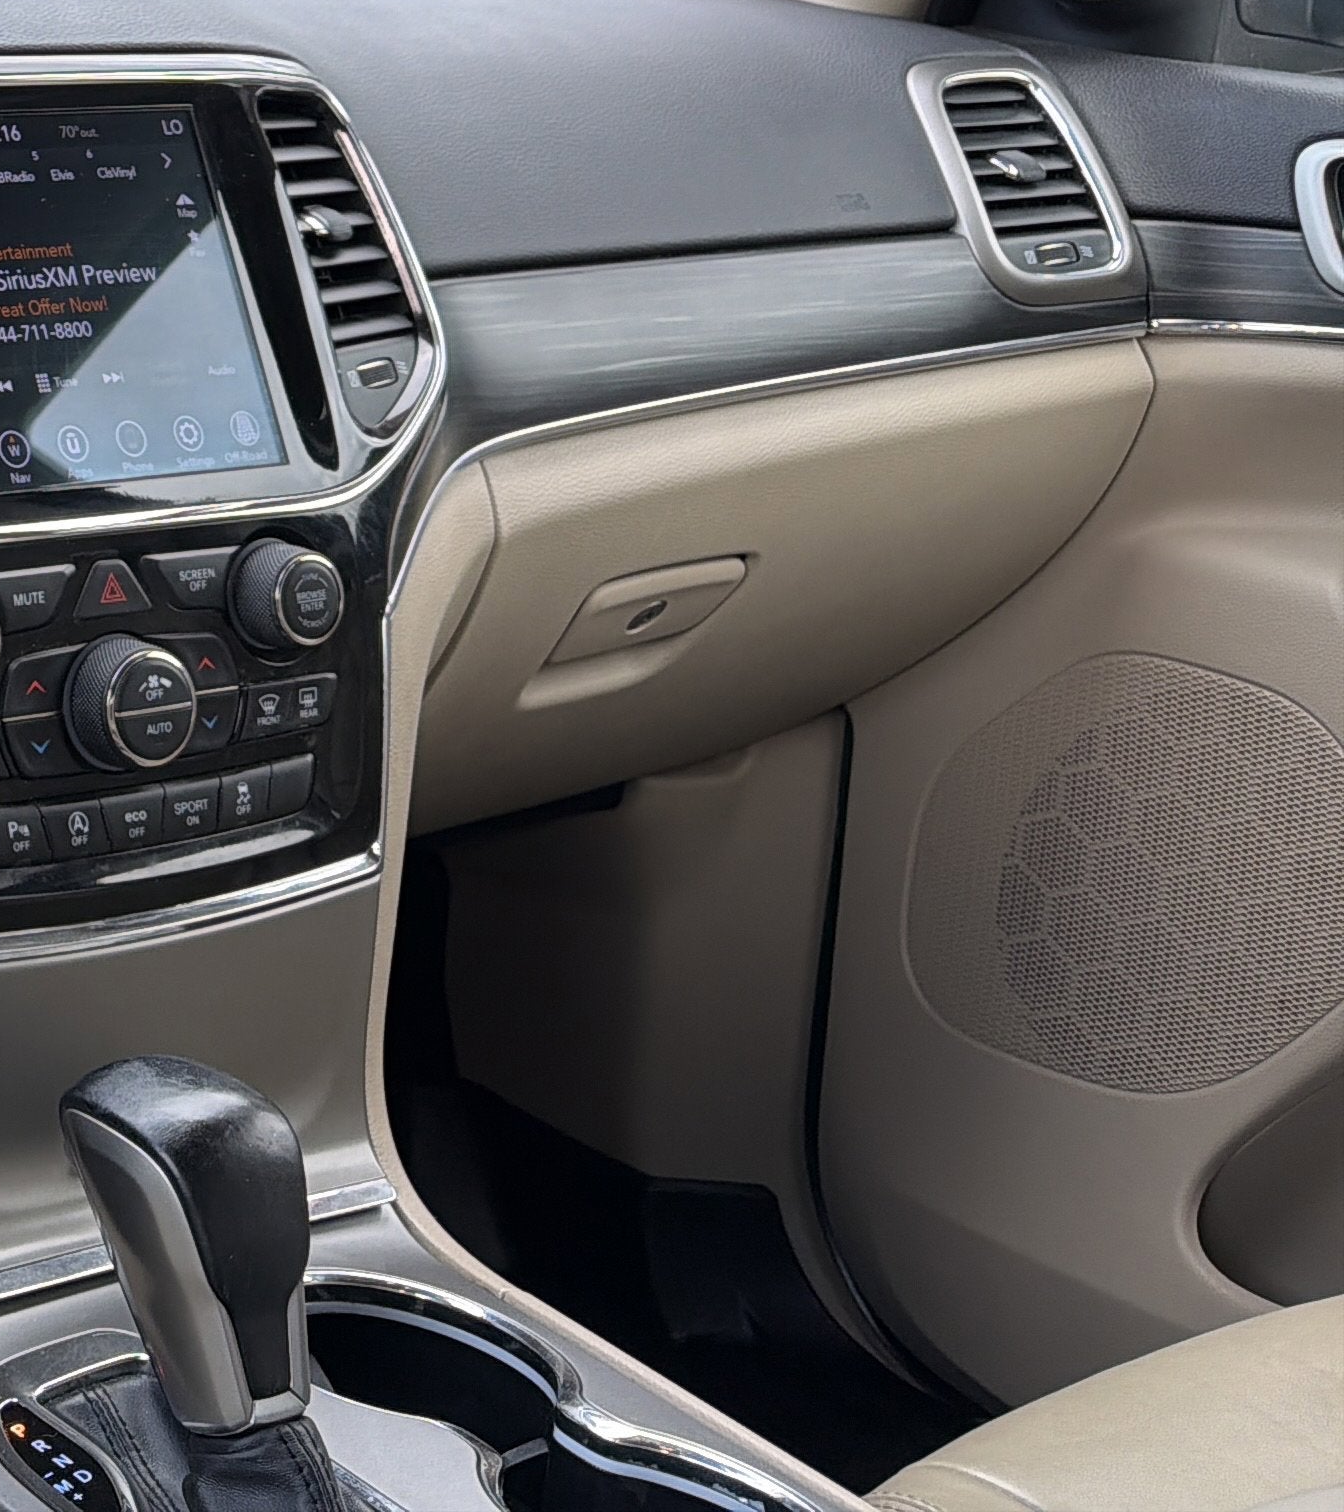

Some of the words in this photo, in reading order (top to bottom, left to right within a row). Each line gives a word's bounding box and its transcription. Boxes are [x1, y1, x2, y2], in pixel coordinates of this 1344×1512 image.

[161, 119, 184, 135] LO
[31, 150, 40, 162] 5
[86, 148, 94, 159] 6
[50, 168, 75, 182] Elvis
[82, 262, 157, 285] Preview
[28, 299, 65, 317] Offer
[69, 295, 109, 314] Now!
[208, 365, 236, 376] Audio
[52, 376, 79, 388] Tune
[10, 472, 32, 484] Nav
[178, 568, 216, 581] SCREEN
[189, 580, 208, 592] OFF
[13, 590, 46, 607] MUTE
[295, 588, 327, 602] BROWSE
[300, 600, 325, 613] ENTER
[145, 689, 165, 702] OFF
[256, 715, 282, 727] FRONT
[299, 709, 319, 720] REAR
[146, 721, 174, 736] AUTO
[174, 798, 209, 816] SPORT
[235, 803, 253, 816] OFF
[124, 810, 148, 823] eco
[186, 815, 200, 827] ON
[128, 826, 146, 838] OFF
[12, 840, 31, 853] OFF
[71, 834, 89, 847] OFF
[10, 1423, 25, 1438] P
[31, 1440, 52, 1452] R
[52, 1454, 74, 1468] N
[72, 1469, 93, 1484] D
[53, 1479, 74, 1493] M
